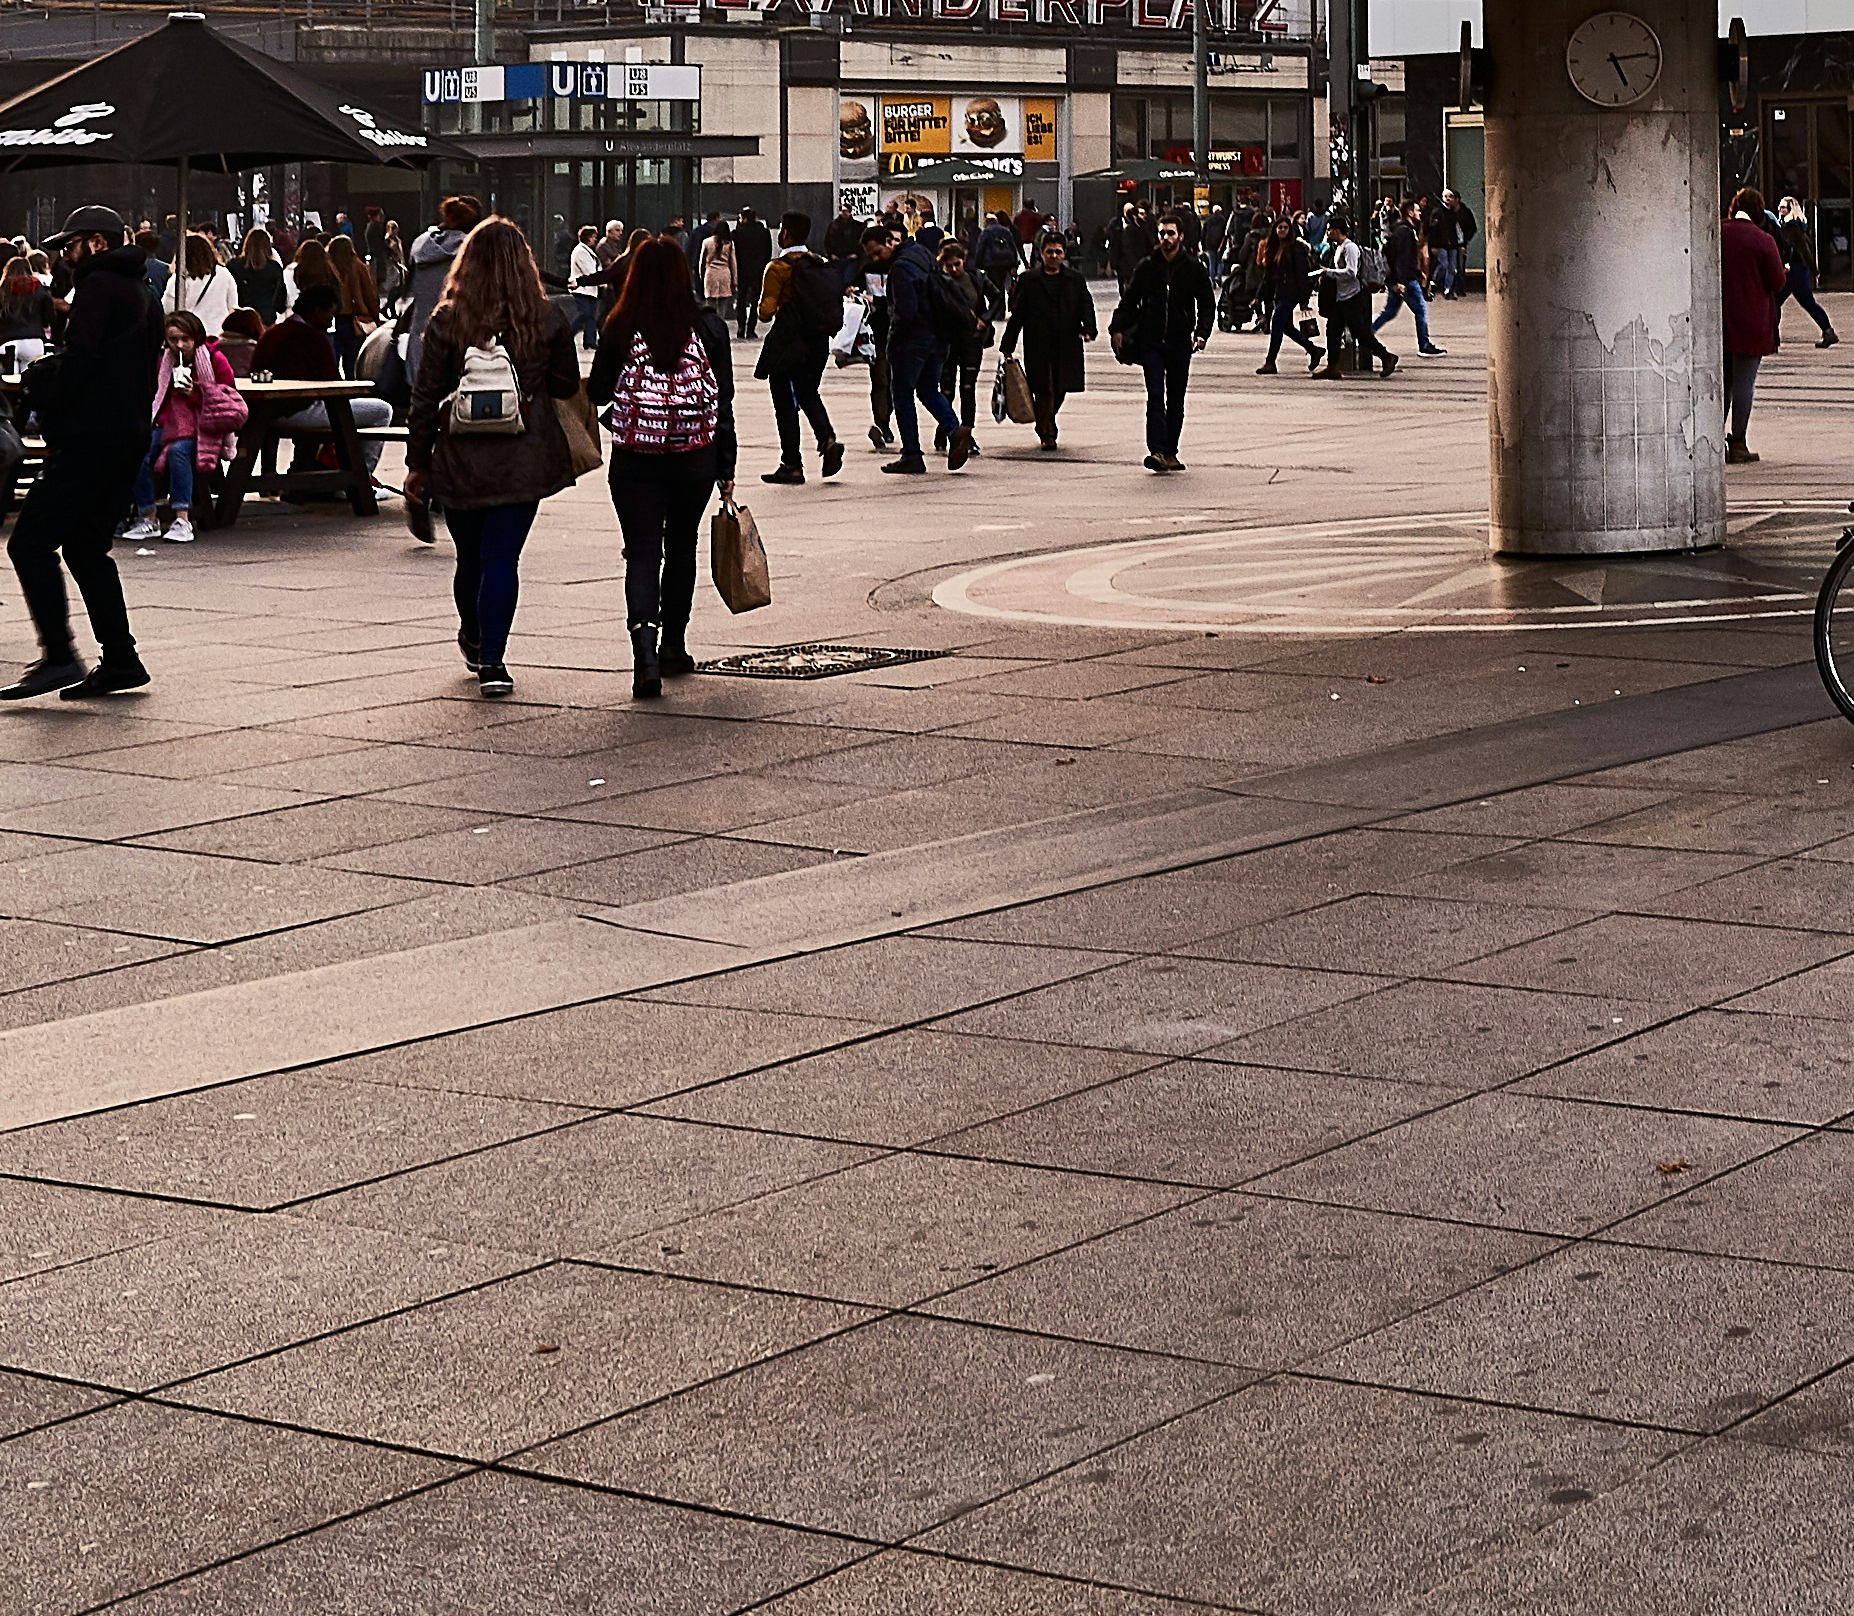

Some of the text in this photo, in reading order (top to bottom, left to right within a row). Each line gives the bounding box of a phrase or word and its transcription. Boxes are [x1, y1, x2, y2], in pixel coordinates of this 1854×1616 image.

[630, 68, 648, 80] U8
[424, 71, 439, 101] U
[552, 65, 575, 96] U
[884, 104, 932, 118] BURGER
[884, 116, 947, 132] FÜR MITTE?
[1026, 113, 1042, 124] ICH
[1026, 122, 1053, 134] LIEBE
[884, 130, 921, 143] BITTE!
[1026, 134, 1042, 145] ES!
[605, 139, 614, 151] U
